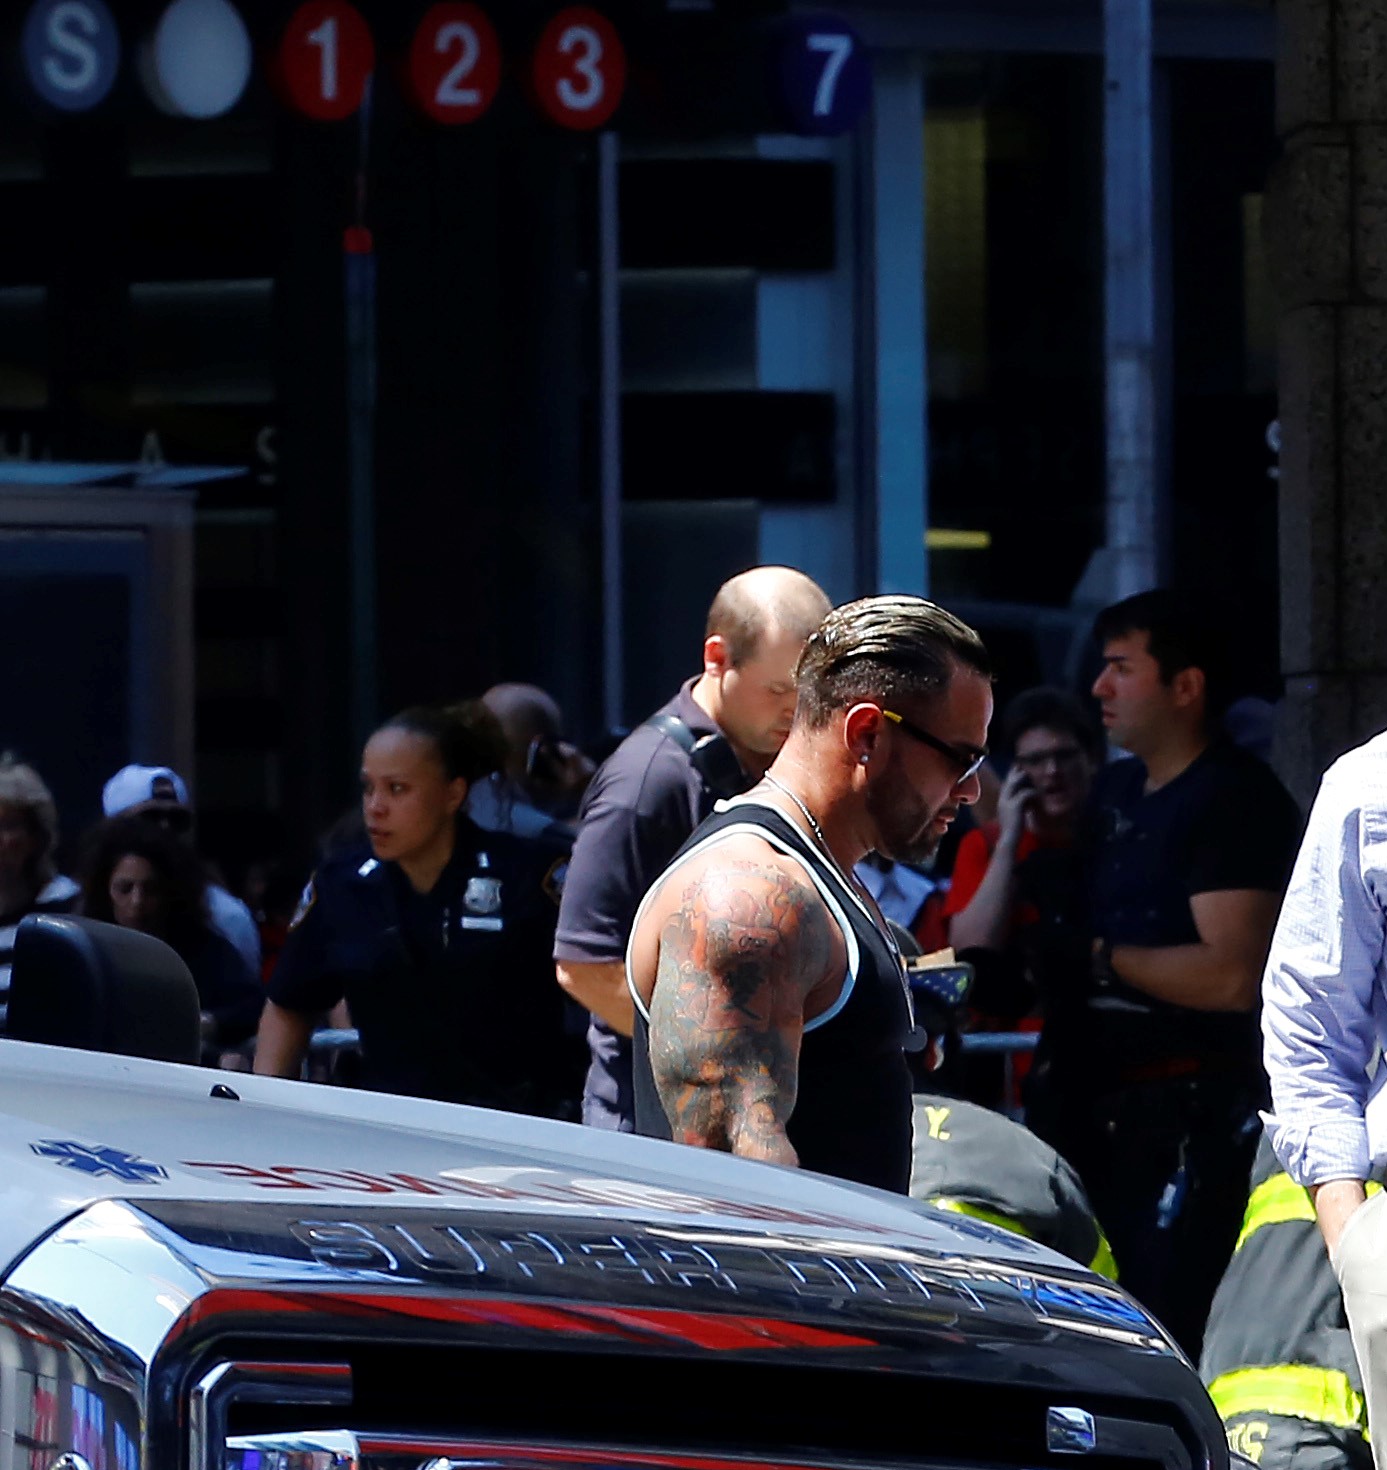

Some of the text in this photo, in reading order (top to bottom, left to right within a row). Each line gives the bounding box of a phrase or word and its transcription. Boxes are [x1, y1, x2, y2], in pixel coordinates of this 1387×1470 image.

[42, 3, 854, 117] S 1 2 3 7
